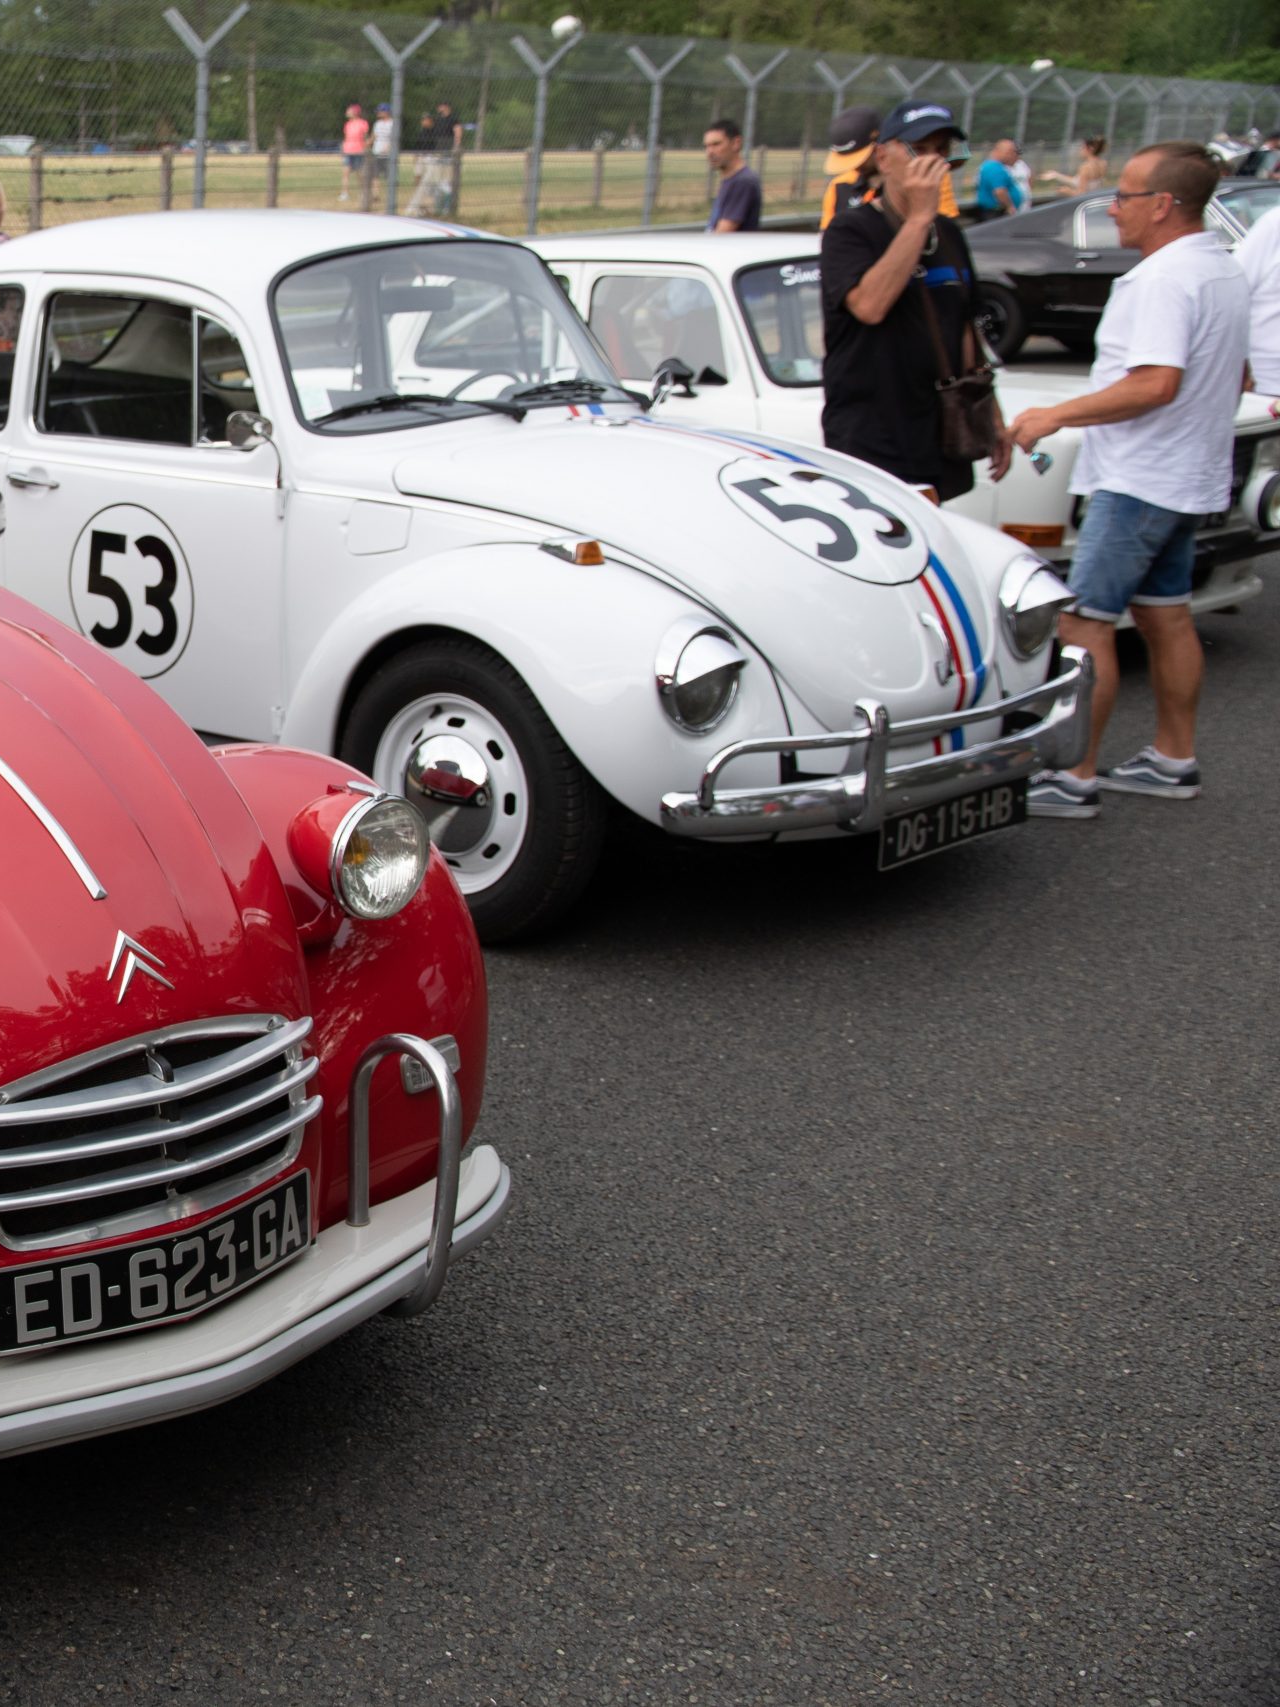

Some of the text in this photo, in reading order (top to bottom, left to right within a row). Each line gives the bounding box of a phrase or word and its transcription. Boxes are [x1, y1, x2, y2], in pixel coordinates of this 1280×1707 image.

[779, 264, 823, 287] Simc
[730, 470, 913, 563] 53
[87, 529, 179, 657] 53
[895, 786, 1014, 858] DG-115-HB
[13, 1185, 303, 1344] ED-623-GA
